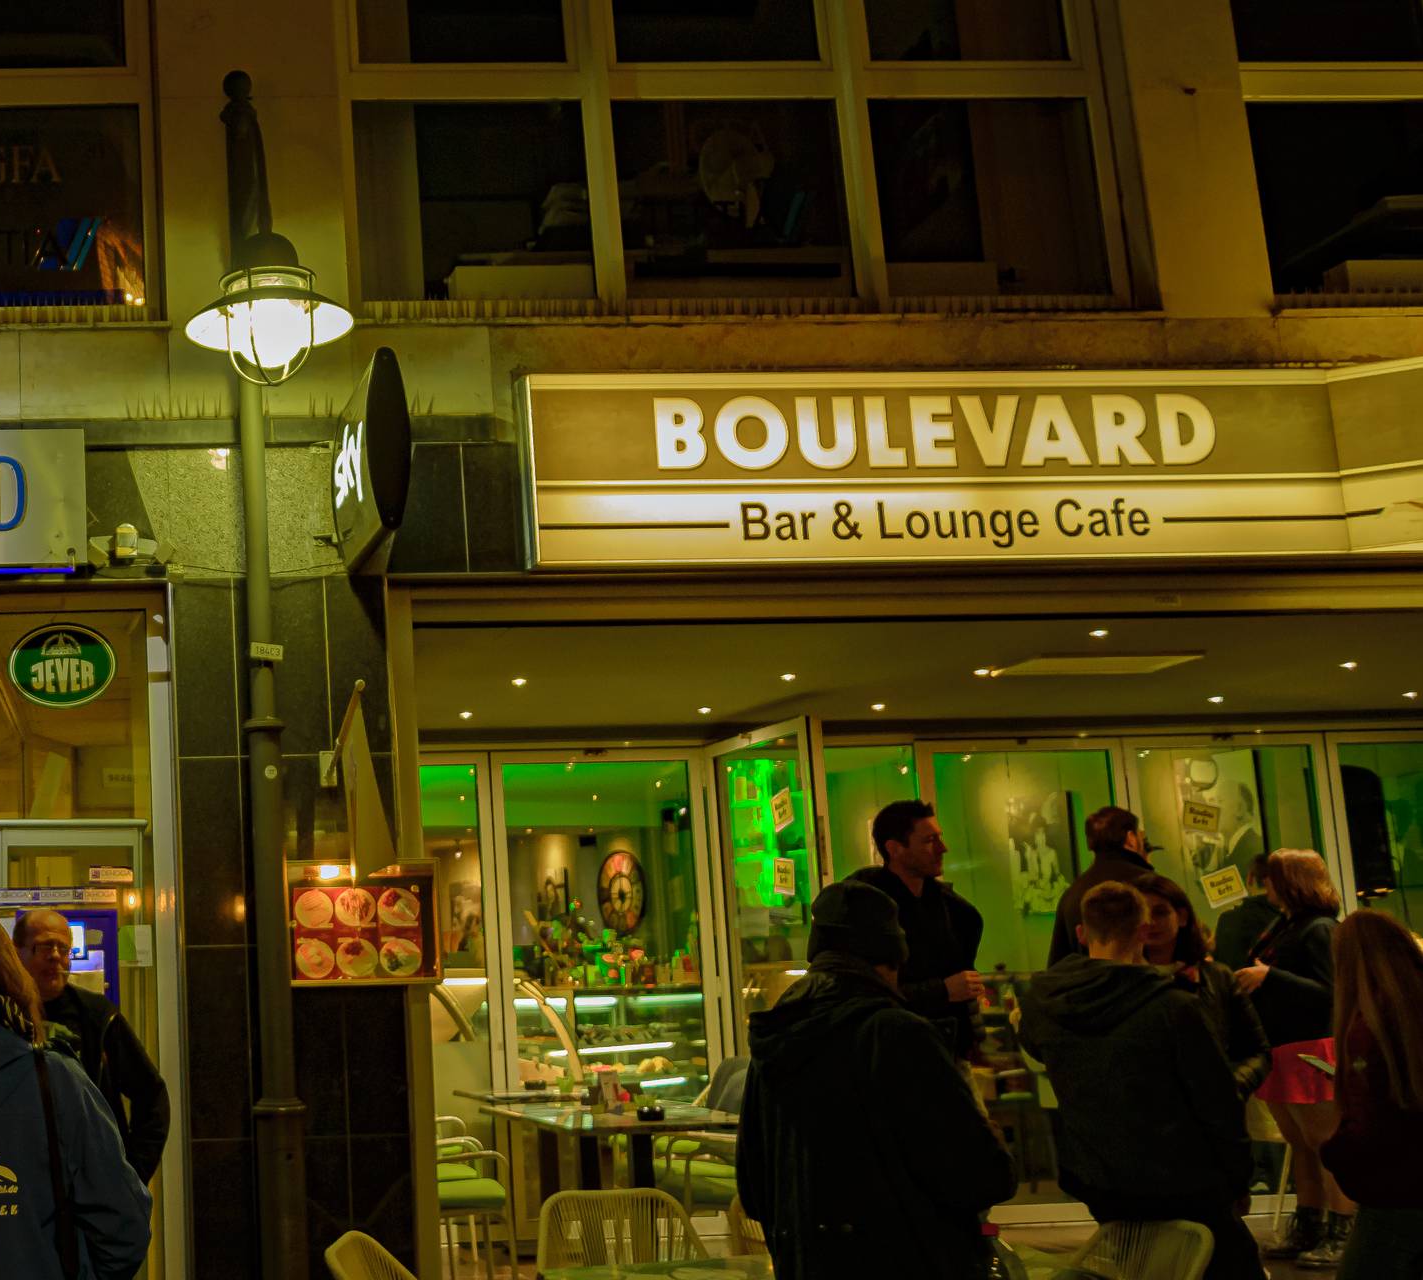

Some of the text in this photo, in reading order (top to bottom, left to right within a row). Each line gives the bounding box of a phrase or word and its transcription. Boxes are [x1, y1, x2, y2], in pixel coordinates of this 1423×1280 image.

[653, 393, 1217, 470] BOULEVARD
[334, 420, 364, 511] sky
[740, 498, 1151, 548] Bar & Lounge Cafe
[31, 657, 95, 693] JEVER
